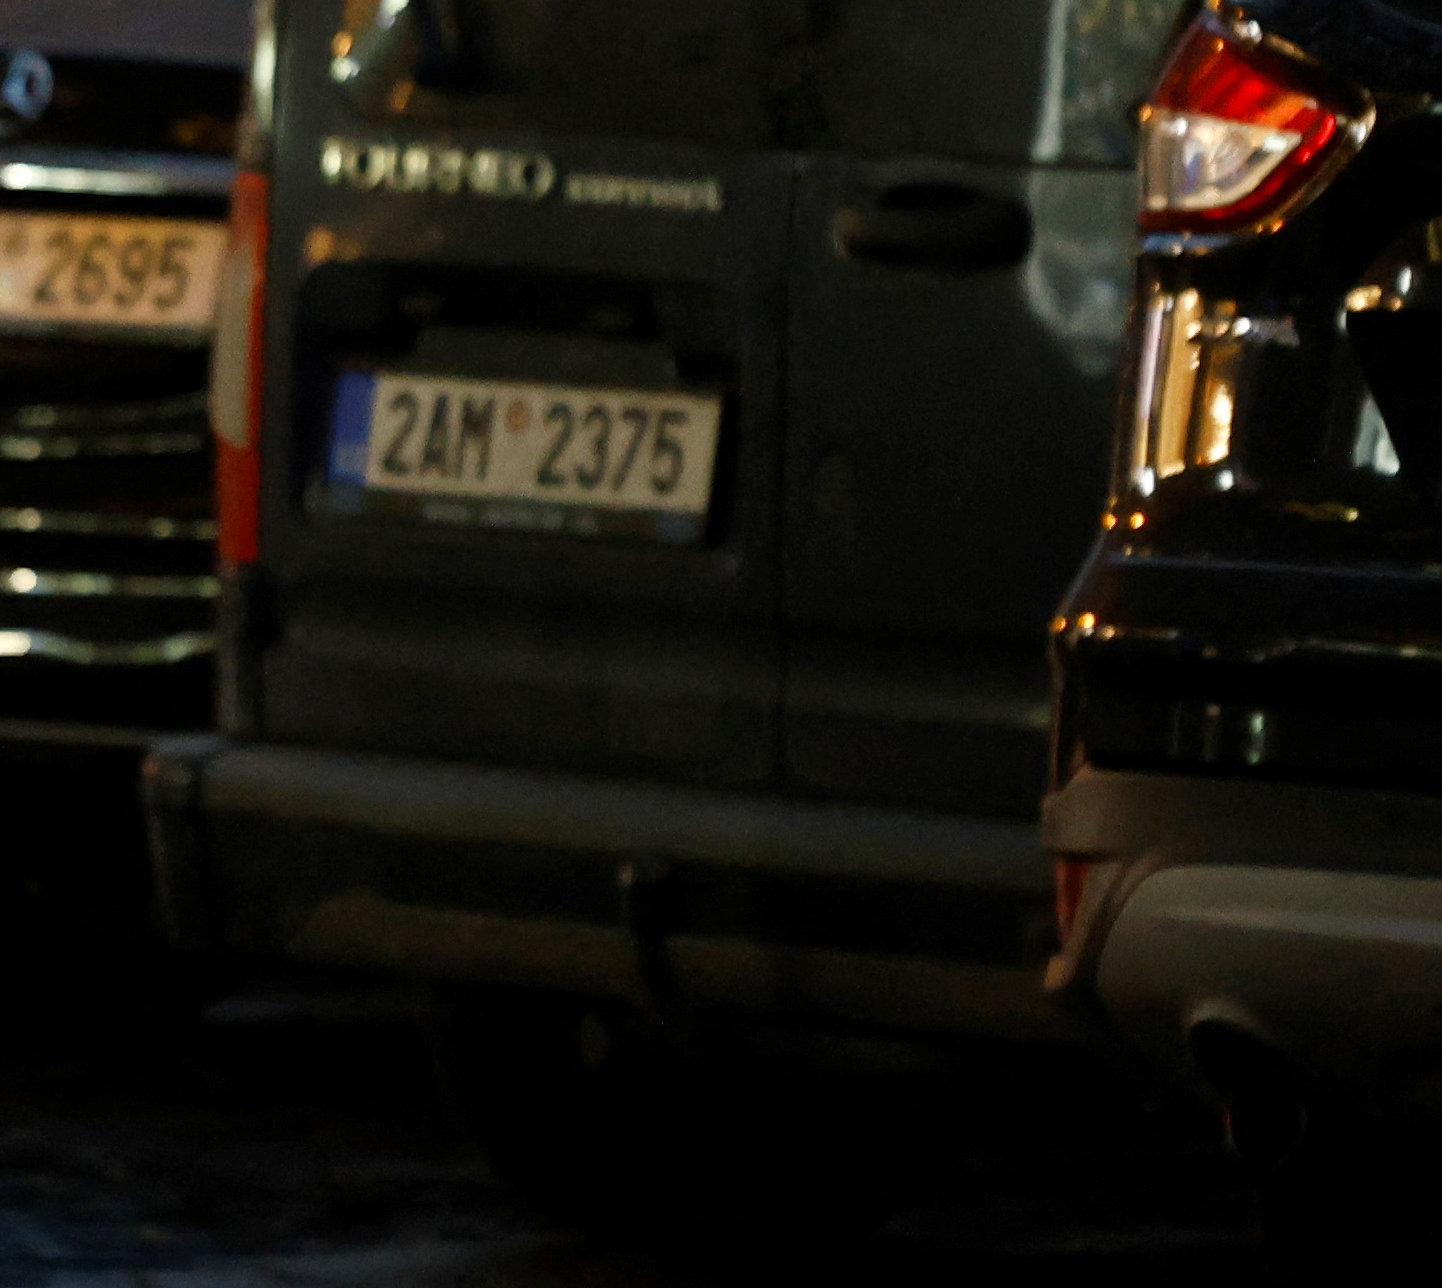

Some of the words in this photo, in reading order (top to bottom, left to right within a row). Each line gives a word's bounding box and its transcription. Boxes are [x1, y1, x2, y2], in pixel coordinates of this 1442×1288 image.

[34, 230, 196, 308] 2695
[380, 390, 495, 481] 2AM
[535, 401, 691, 496] 2375
